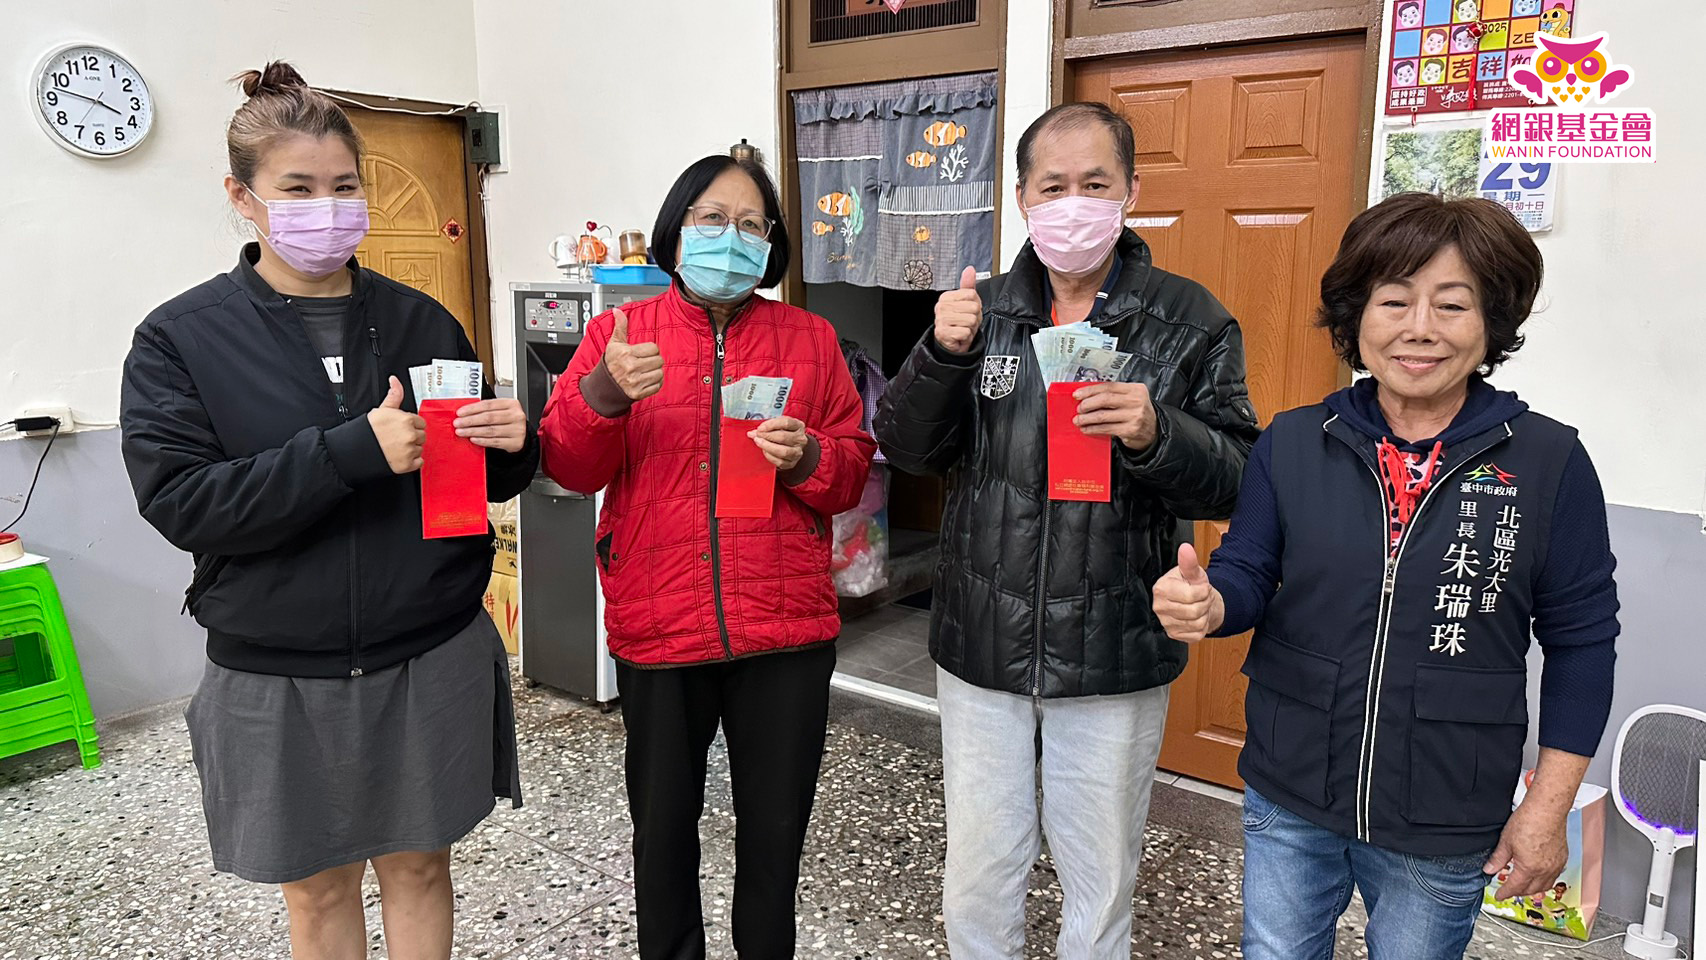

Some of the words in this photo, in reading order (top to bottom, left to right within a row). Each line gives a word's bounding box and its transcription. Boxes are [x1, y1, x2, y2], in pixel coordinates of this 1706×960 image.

[65, 60, 79, 75] 11
[81, 55, 99, 71] 12
[109, 64, 116, 78] 1
[51, 72, 70, 87] 10
[122, 78, 132, 92] 2
[46, 91, 58, 106] 9
[130, 97, 140, 111] 3
[56, 111, 68, 125] 8
[127, 115, 137, 128] 4
[74, 125, 85, 139] 7
[94, 131, 105, 145] 6
[115, 127, 125, 141] 5
[468, 366, 480, 396] 1000
[747, 383, 757, 400] 1000
[773, 385, 789, 410] 1000
[1459, 481, 1518, 497] 臺中市政府
[1478, 505, 1522, 613] 北區光大里
